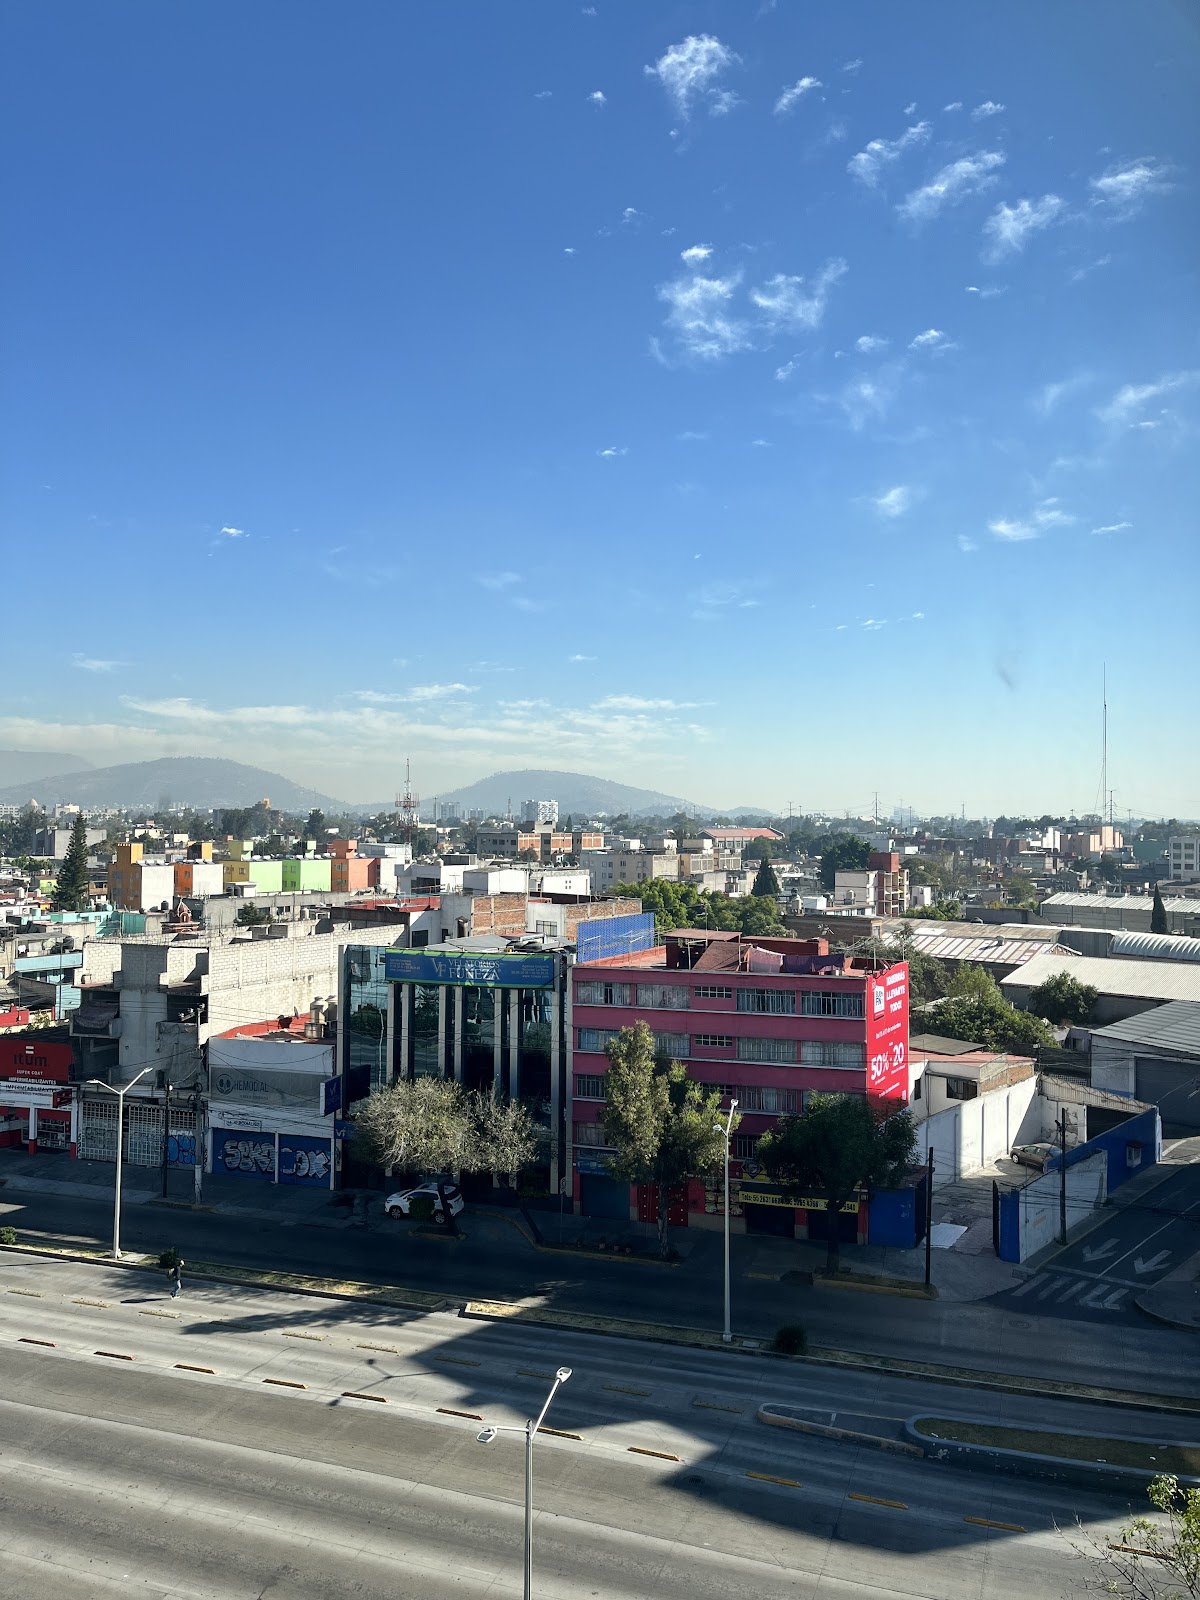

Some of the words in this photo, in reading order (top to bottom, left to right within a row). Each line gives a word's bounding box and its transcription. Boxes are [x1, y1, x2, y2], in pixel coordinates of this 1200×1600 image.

[448, 959, 500, 969] VELATORIOS
[449, 968, 500, 980] FUNEZA
[886, 985, 905, 1000] LLEVARTE
[871, 1051, 889, 1080] 50%
[893, 1042, 905, 1067] 20
